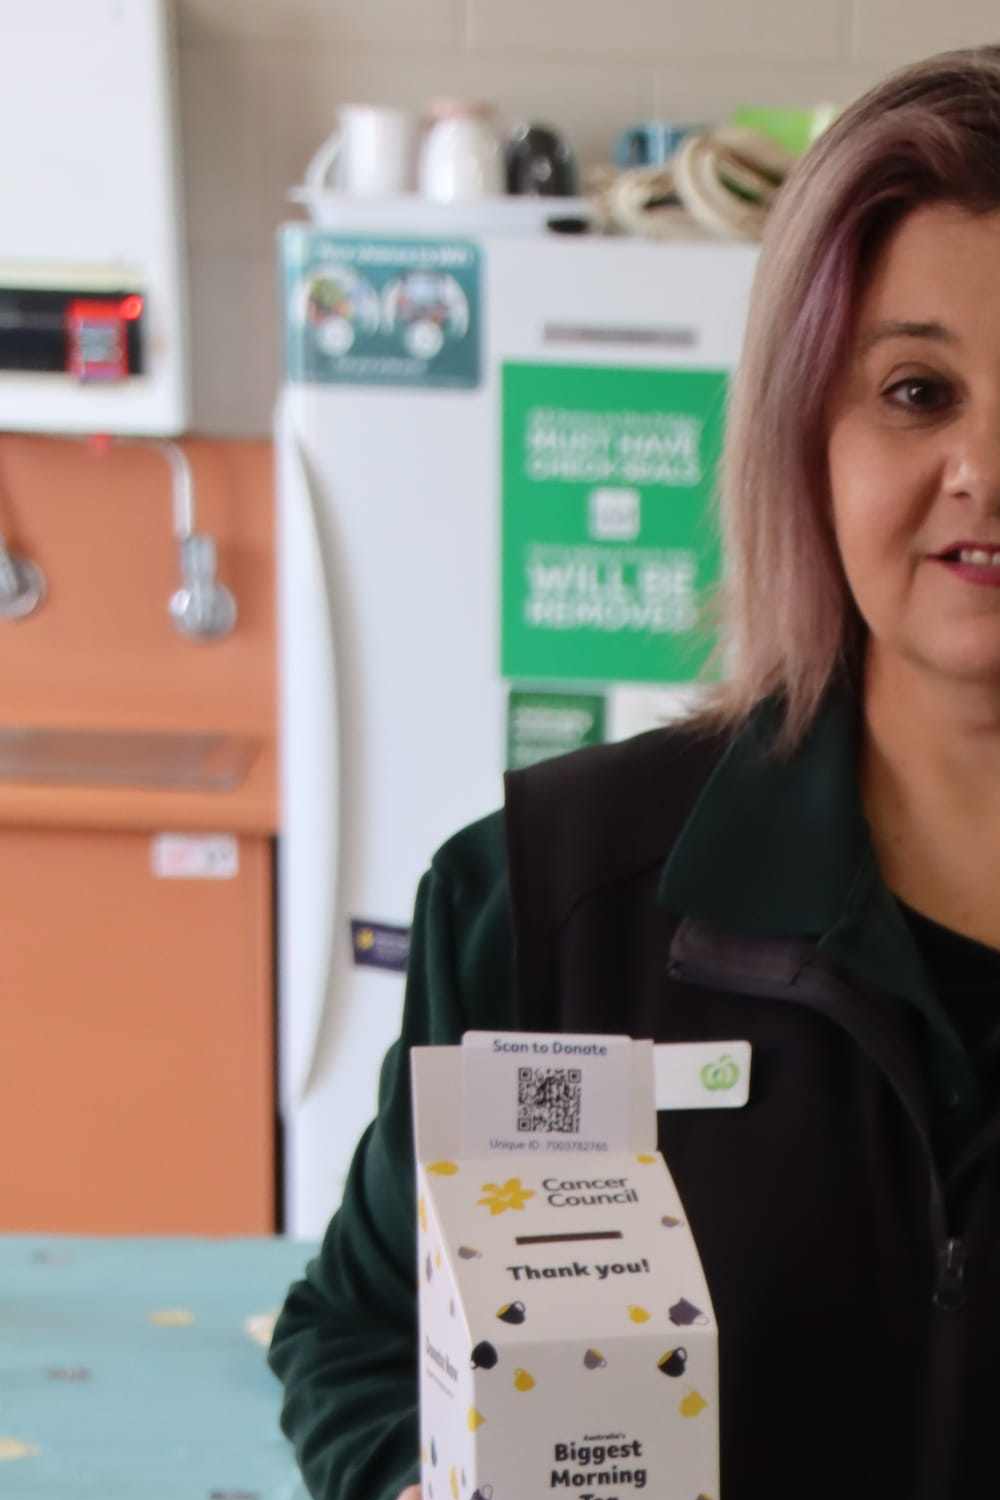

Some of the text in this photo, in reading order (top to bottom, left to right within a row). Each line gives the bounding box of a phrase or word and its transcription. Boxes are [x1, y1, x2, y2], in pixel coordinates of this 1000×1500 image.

[493, 1039, 608, 1056] Scan to Donate
[489, 1138, 526, 1151] Unique
[542, 1177, 628, 1192] Cancer
[547, 1189, 639, 1208] Council
[506, 1259, 650, 1281] Thank you!
[554, 1439, 643, 1465] Biggest
[550, 1467, 647, 1488] Morning
